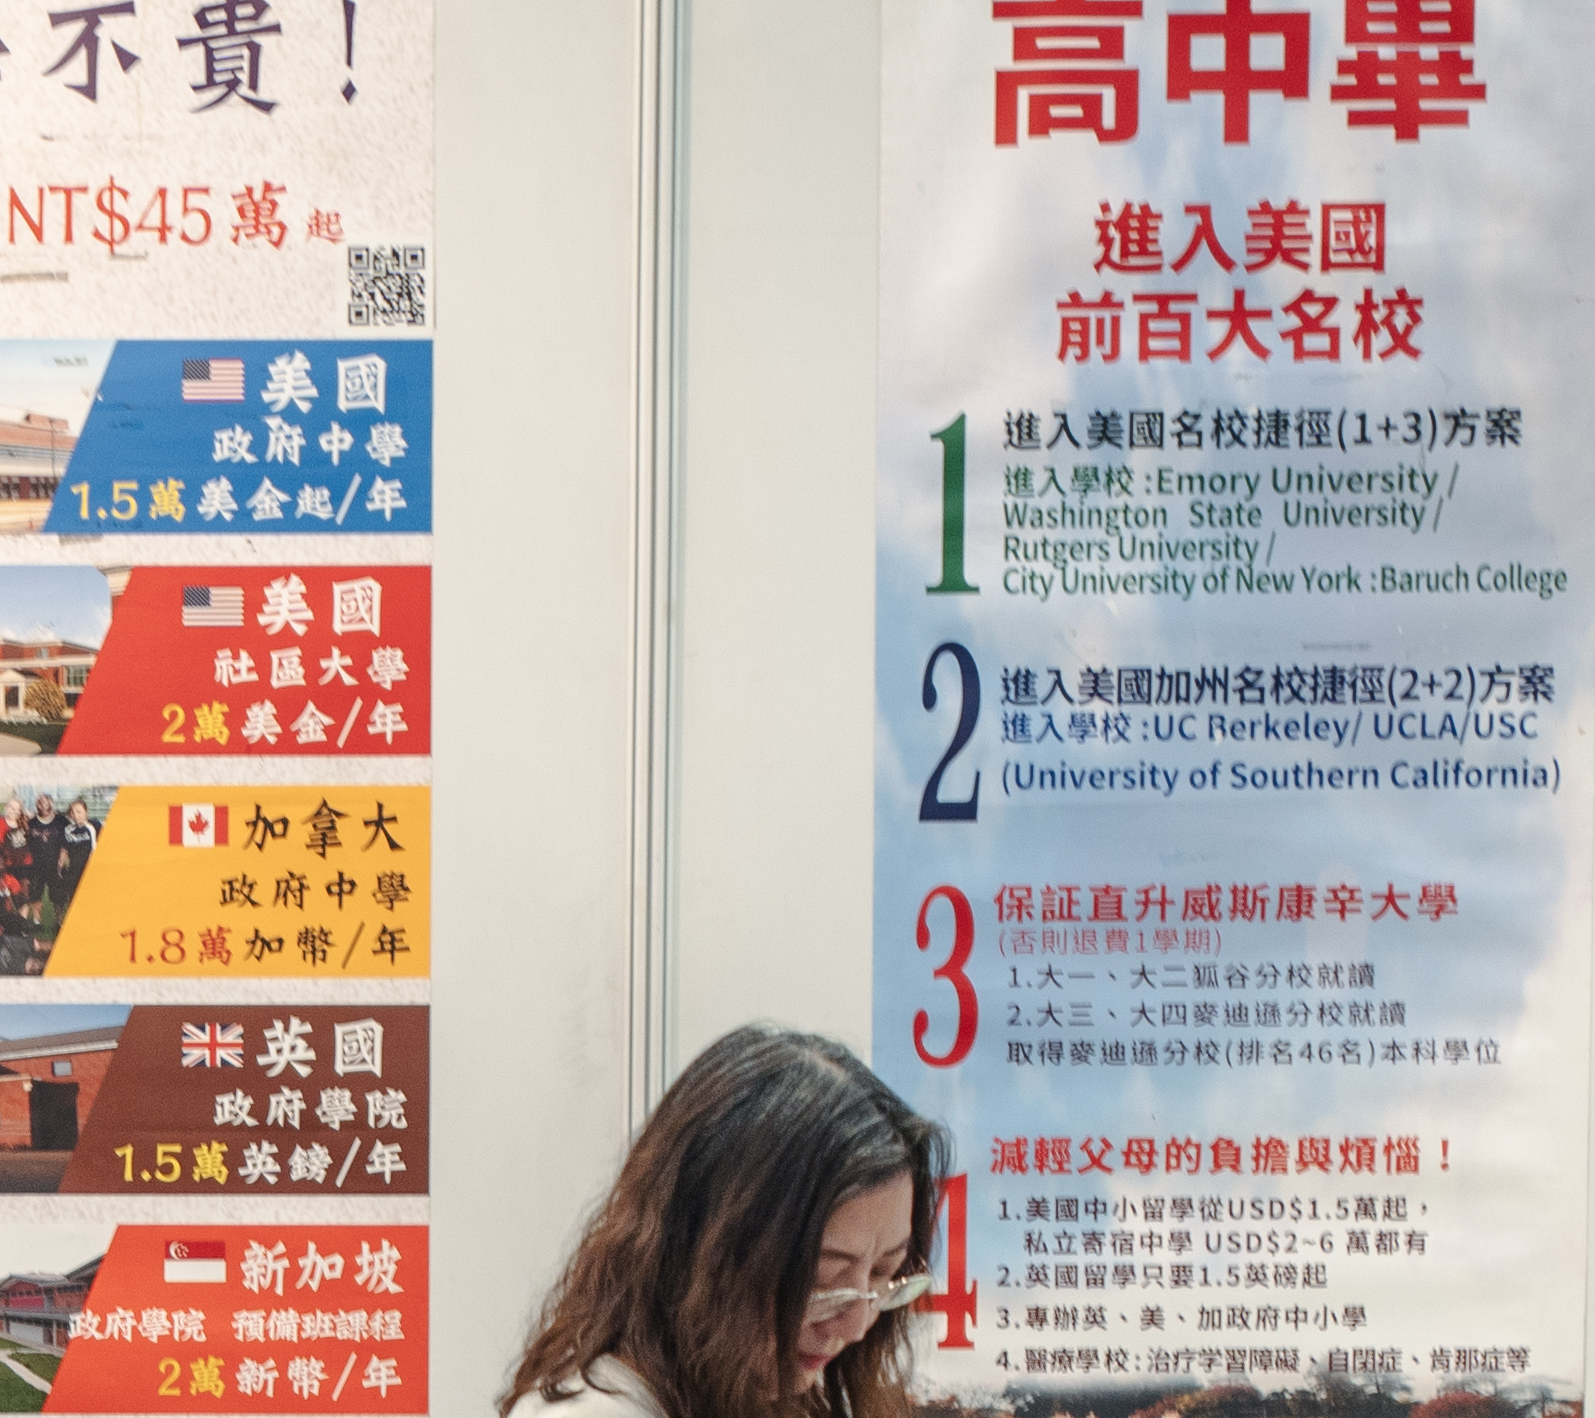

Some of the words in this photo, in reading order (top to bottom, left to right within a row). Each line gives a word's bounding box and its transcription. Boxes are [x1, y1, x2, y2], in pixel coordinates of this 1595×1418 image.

[991, 0, 1487, 148] 高中畢
[1093, 200, 1387, 275] 進入美國
[1055, 287, 1425, 365] 前百大名校
[262, 350, 389, 414] 美國
[212, 420, 409, 467] 政府中學
[1003, 408, 1523, 453] 進入美國名校捷徑(1+3)方案
[69, 473, 409, 526] 1.5萬美金起/年
[1003, 500, 1169, 537] Washington
[1189, 500, 1263, 530] State
[1003, 533, 1112, 570] Rutgers
[1003, 566, 1055, 601] City
[1060, 565, 1197, 601] University
[1203, 565, 1231, 596] of
[1235, 567, 1295, 595] New
[1301, 562, 1362, 594] York
[1476, 561, 1569, 601] College
[258, 574, 383, 639] 美國
[213, 648, 409, 692] 社區大學
[1001, 664, 1556, 708] 進入美國加州名校捷徑(2+2)方案
[161, 697, 409, 750] 2萬美金/年
[1372, 709, 1539, 747] UCLA/USC
[1001, 757, 1180, 798] (University
[1188, 758, 1223, 791] of
[1229, 757, 1380, 791] Southern
[1389, 757, 1561, 796] California)
[243, 797, 405, 860] 加拿大
[220, 870, 411, 914] 政府中學
[993, 881, 1459, 924] 保証直升威斯康辛大學
[119, 918, 411, 971] 1.8萬加幣/年
[998, 928, 1222, 958] (否則退費1學期)
[257, 1016, 384, 1081] 英國
[213, 1087, 409, 1132] 政府學院
[990, 1134, 1451, 1177] 減輕父母的負擔與煩惱！
[1023, 1228, 1194, 1256] 私立寄宿中學
[1345, 1228, 1429, 1256] 萬都有
[240, 1238, 405, 1298] 新加坡
[67, 1307, 207, 1345] 政府學院
[231, 1307, 406, 1345] 預備班課程
[157, 1351, 402, 1402] 2萬新幣/年
